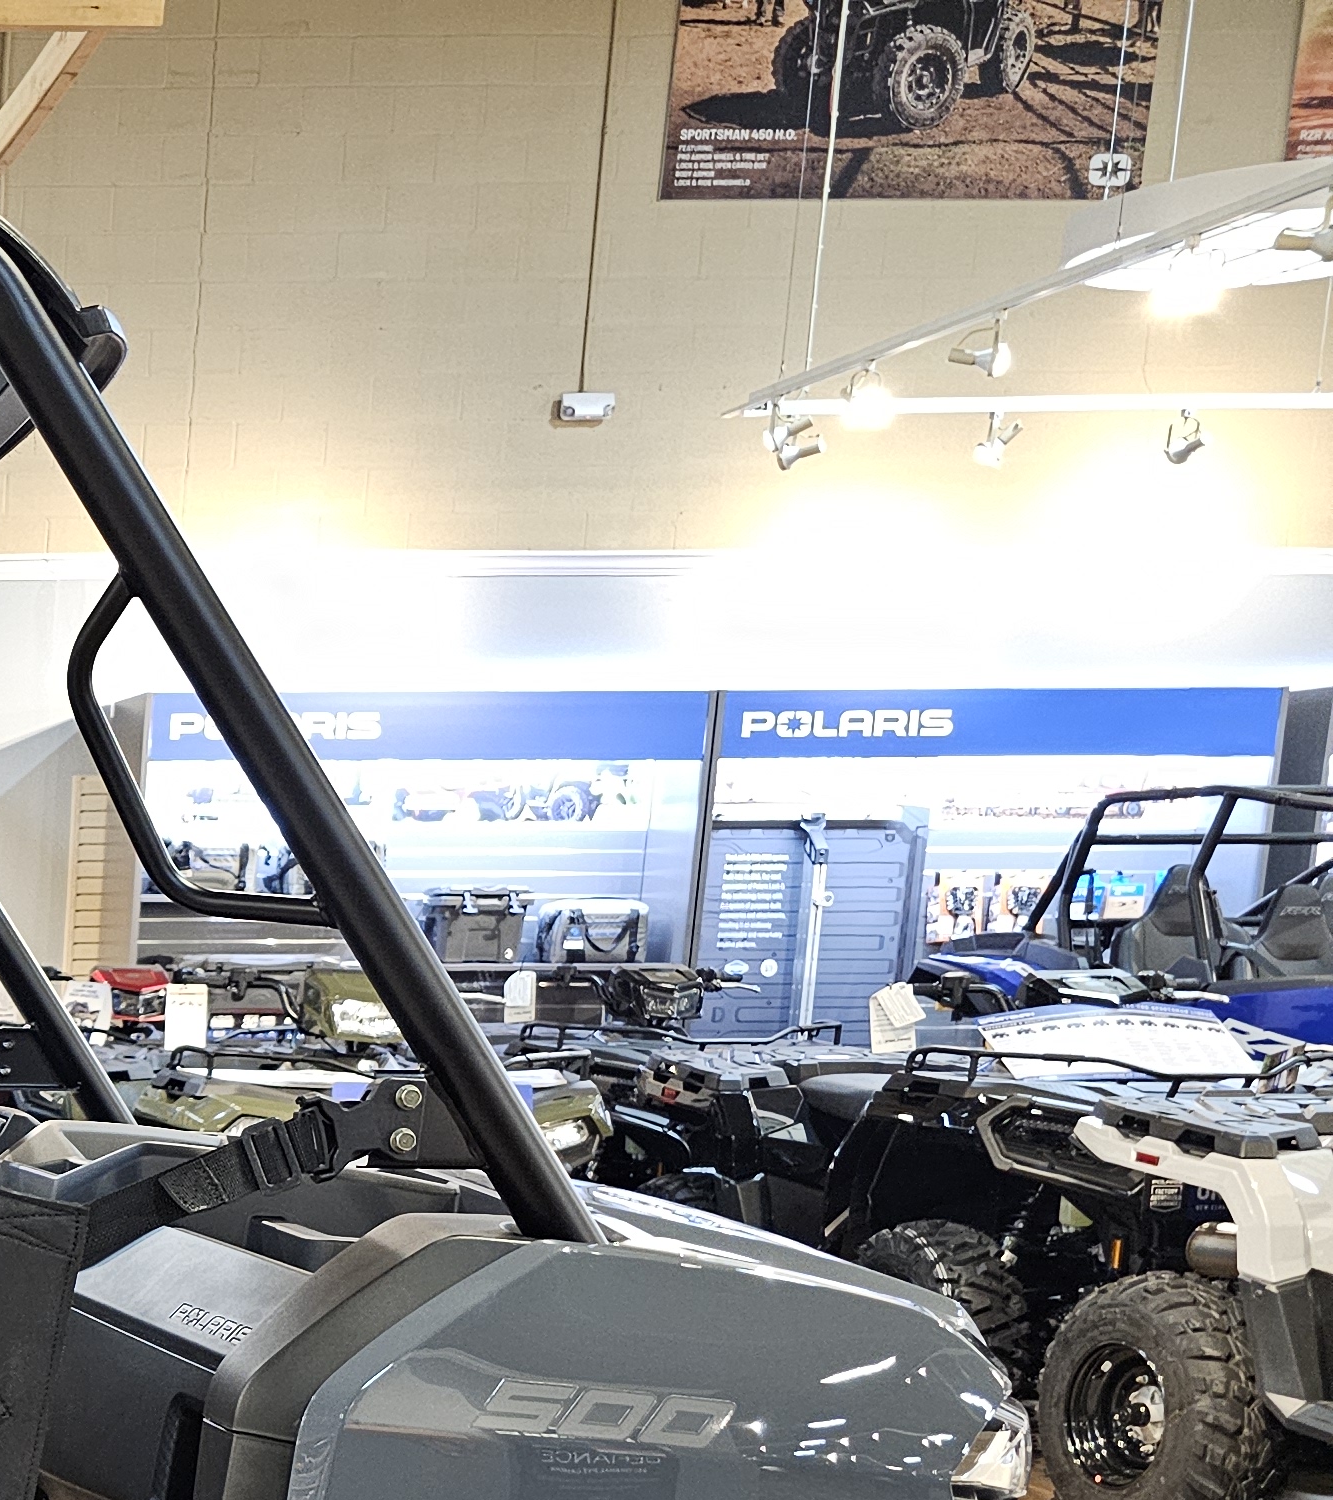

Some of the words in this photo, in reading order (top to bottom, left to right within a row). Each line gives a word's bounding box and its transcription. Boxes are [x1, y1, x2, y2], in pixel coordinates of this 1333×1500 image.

[680, 129, 750, 141] SPORTSMAN
[751, 129, 774, 141] 450
[741, 709, 953, 738] POLARIS
[469, 1377, 736, 1448] 500
